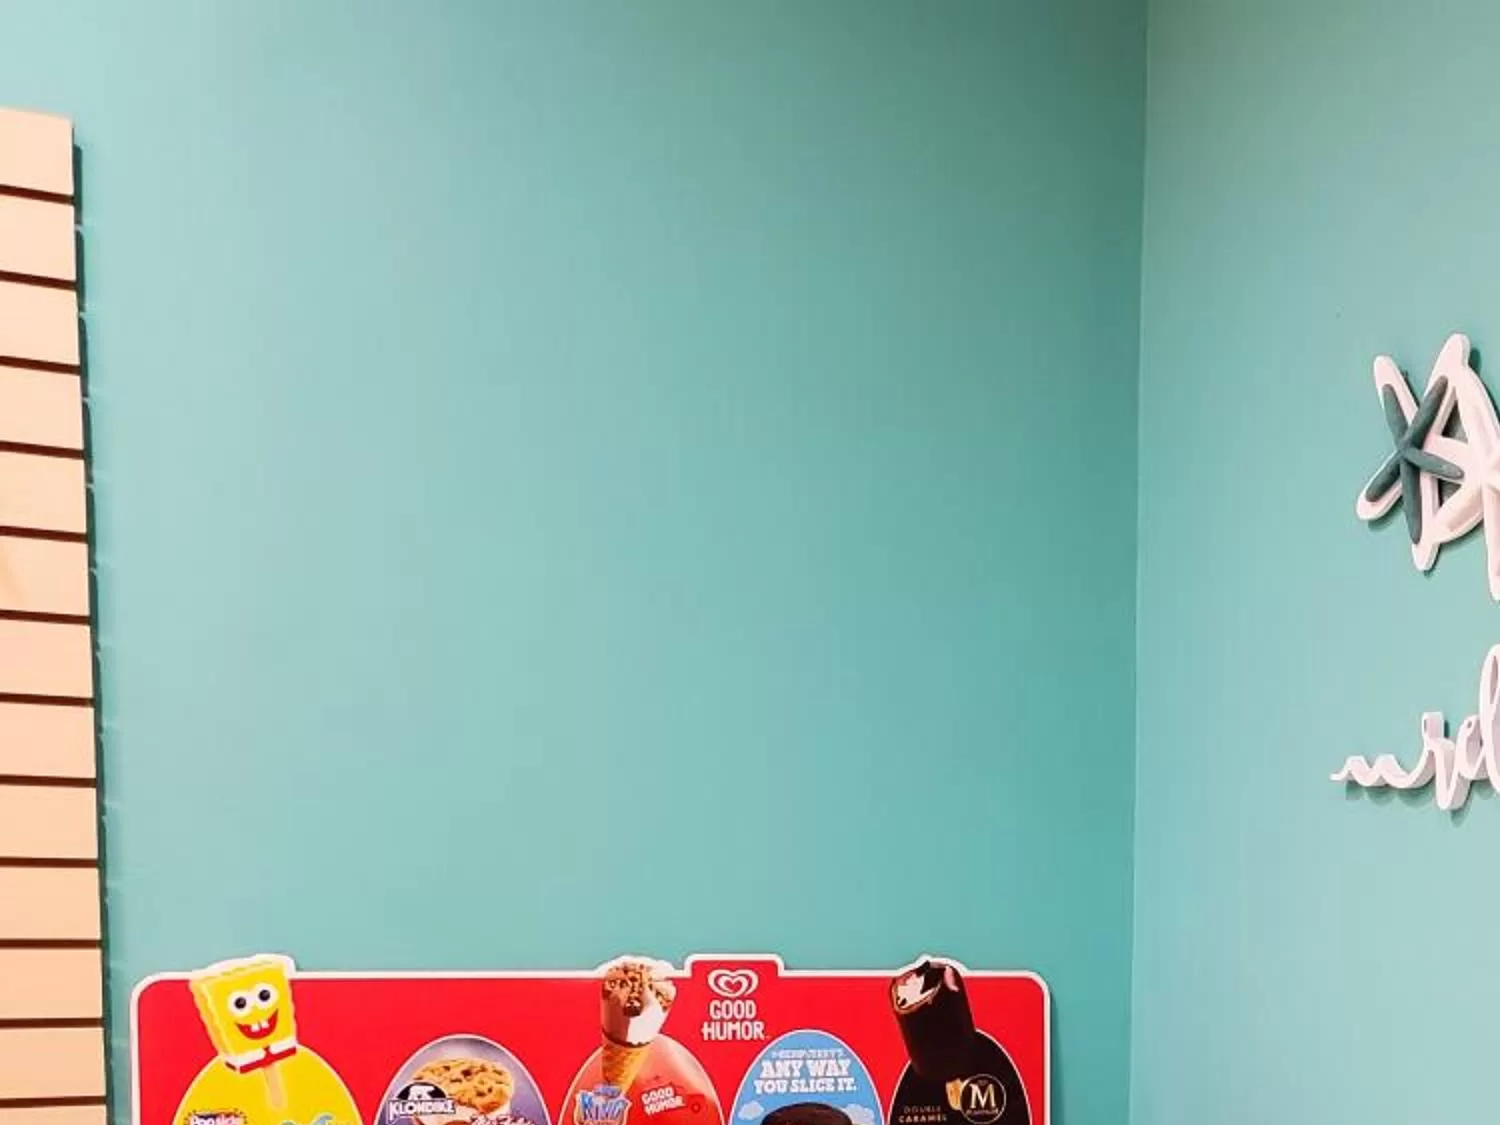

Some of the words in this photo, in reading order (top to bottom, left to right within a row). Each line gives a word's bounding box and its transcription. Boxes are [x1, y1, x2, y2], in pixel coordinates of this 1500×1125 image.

[708, 1000, 756, 1021] GOOD
[702, 1020, 765, 1041] HUMOR
[760, 1060, 804, 1079] ANY
[806, 1059, 850, 1078] WAY
[753, 1079, 788, 1095] YOU
[789, 1079, 834, 1094] SLICE
[969, 1083, 997, 1109] M
